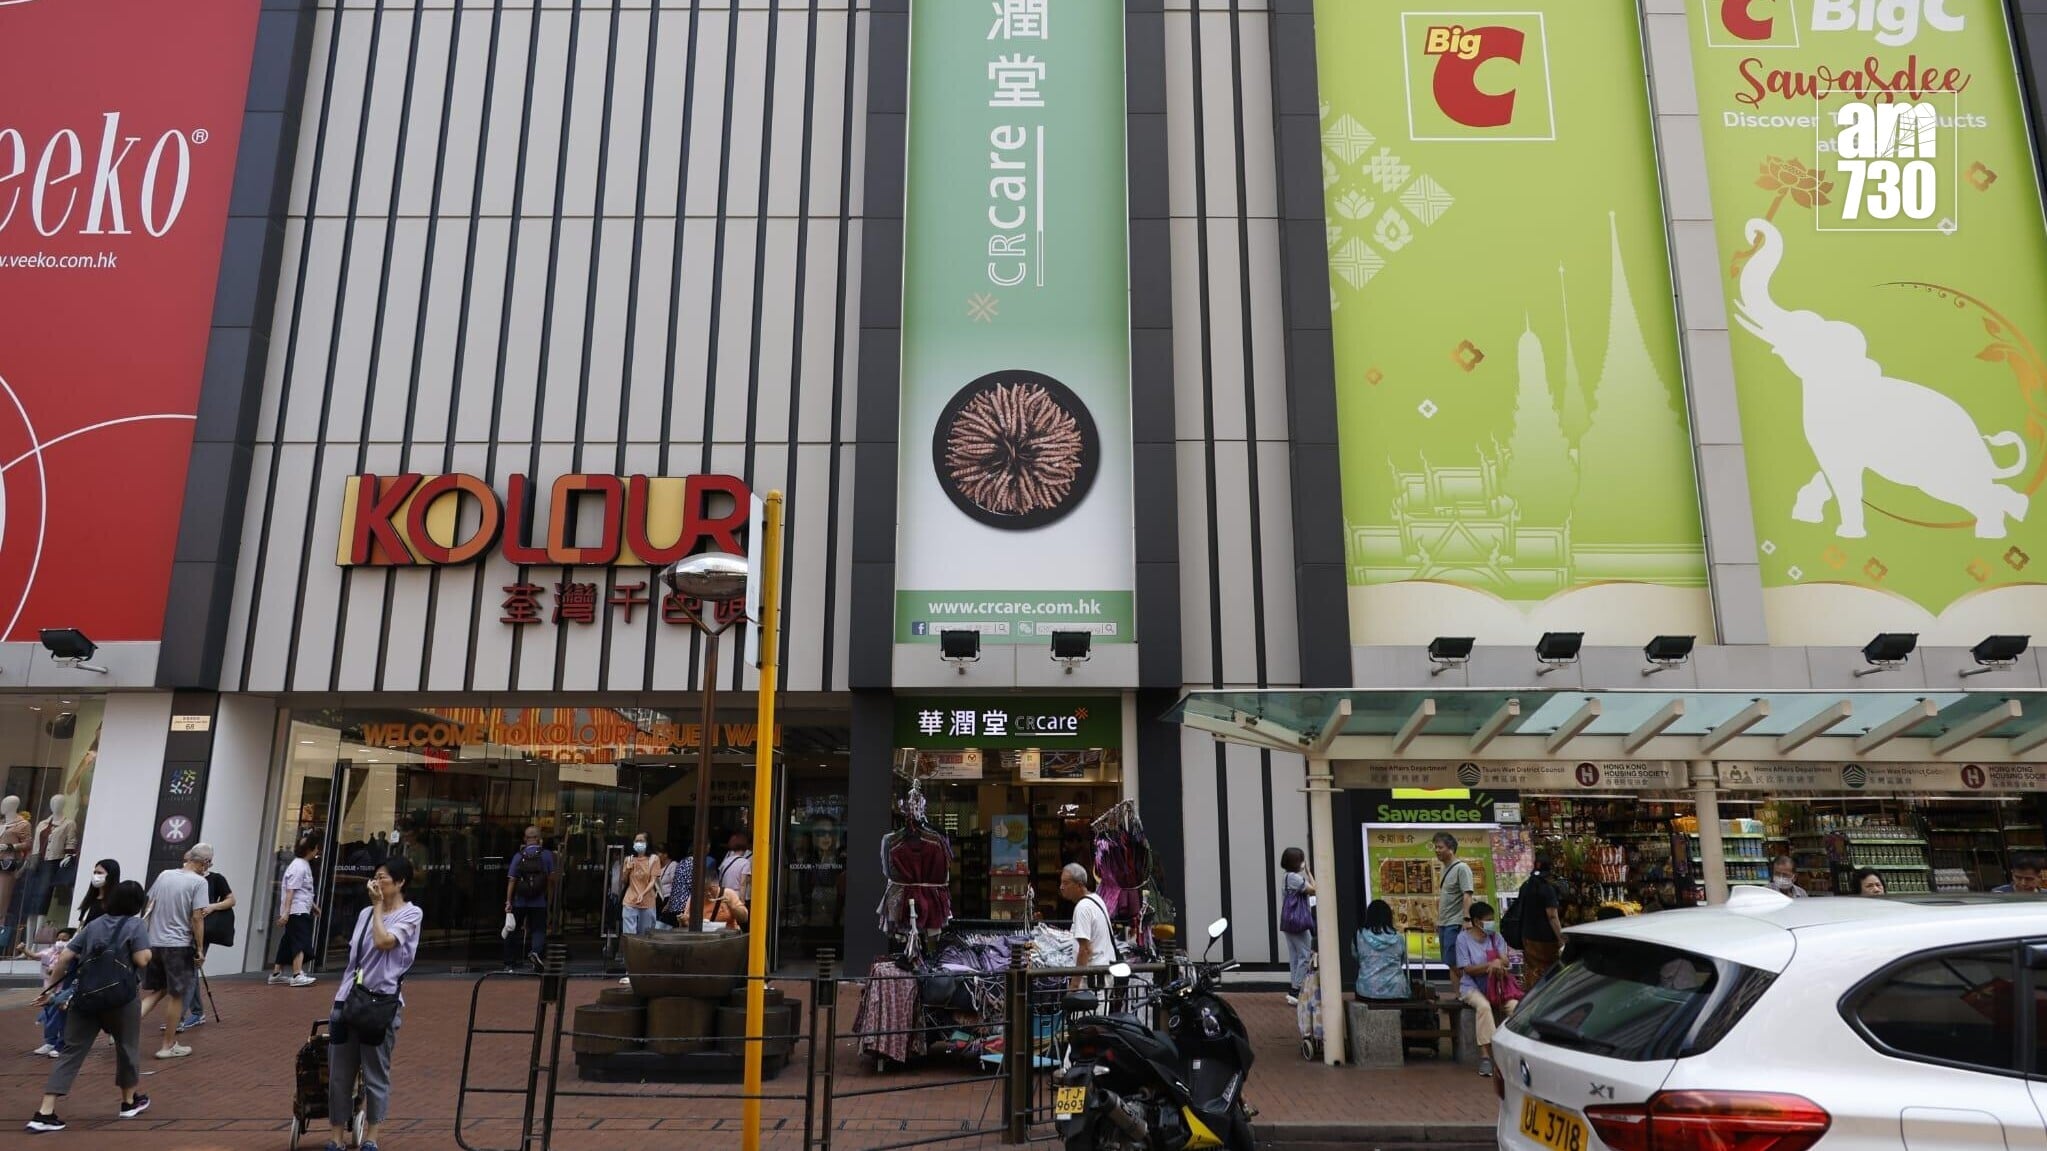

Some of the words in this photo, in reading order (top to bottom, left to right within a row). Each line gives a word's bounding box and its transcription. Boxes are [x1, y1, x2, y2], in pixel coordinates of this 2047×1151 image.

[1735, 55, 1971, 110] Sawasdee
[1723, 112, 1818, 128] Discover
[988, 124, 1026, 287] CRcare
[350, 472, 753, 566] KOLOUR
[928, 598, 1101, 615] www.crcare.com.hk
[362, 722, 484, 747] WELCOME
[536, 723, 629, 746] KOLOUR
[918, 709, 1008, 737] 華潤堂
[1014, 713, 1078, 731] CRcare
[1377, 804, 1482, 822] Sawasdee
[1589, 1082, 1614, 1099] X1
[1056, 1100, 1083, 1111] 9693
[1545, 1111, 1580, 1151] 3718
